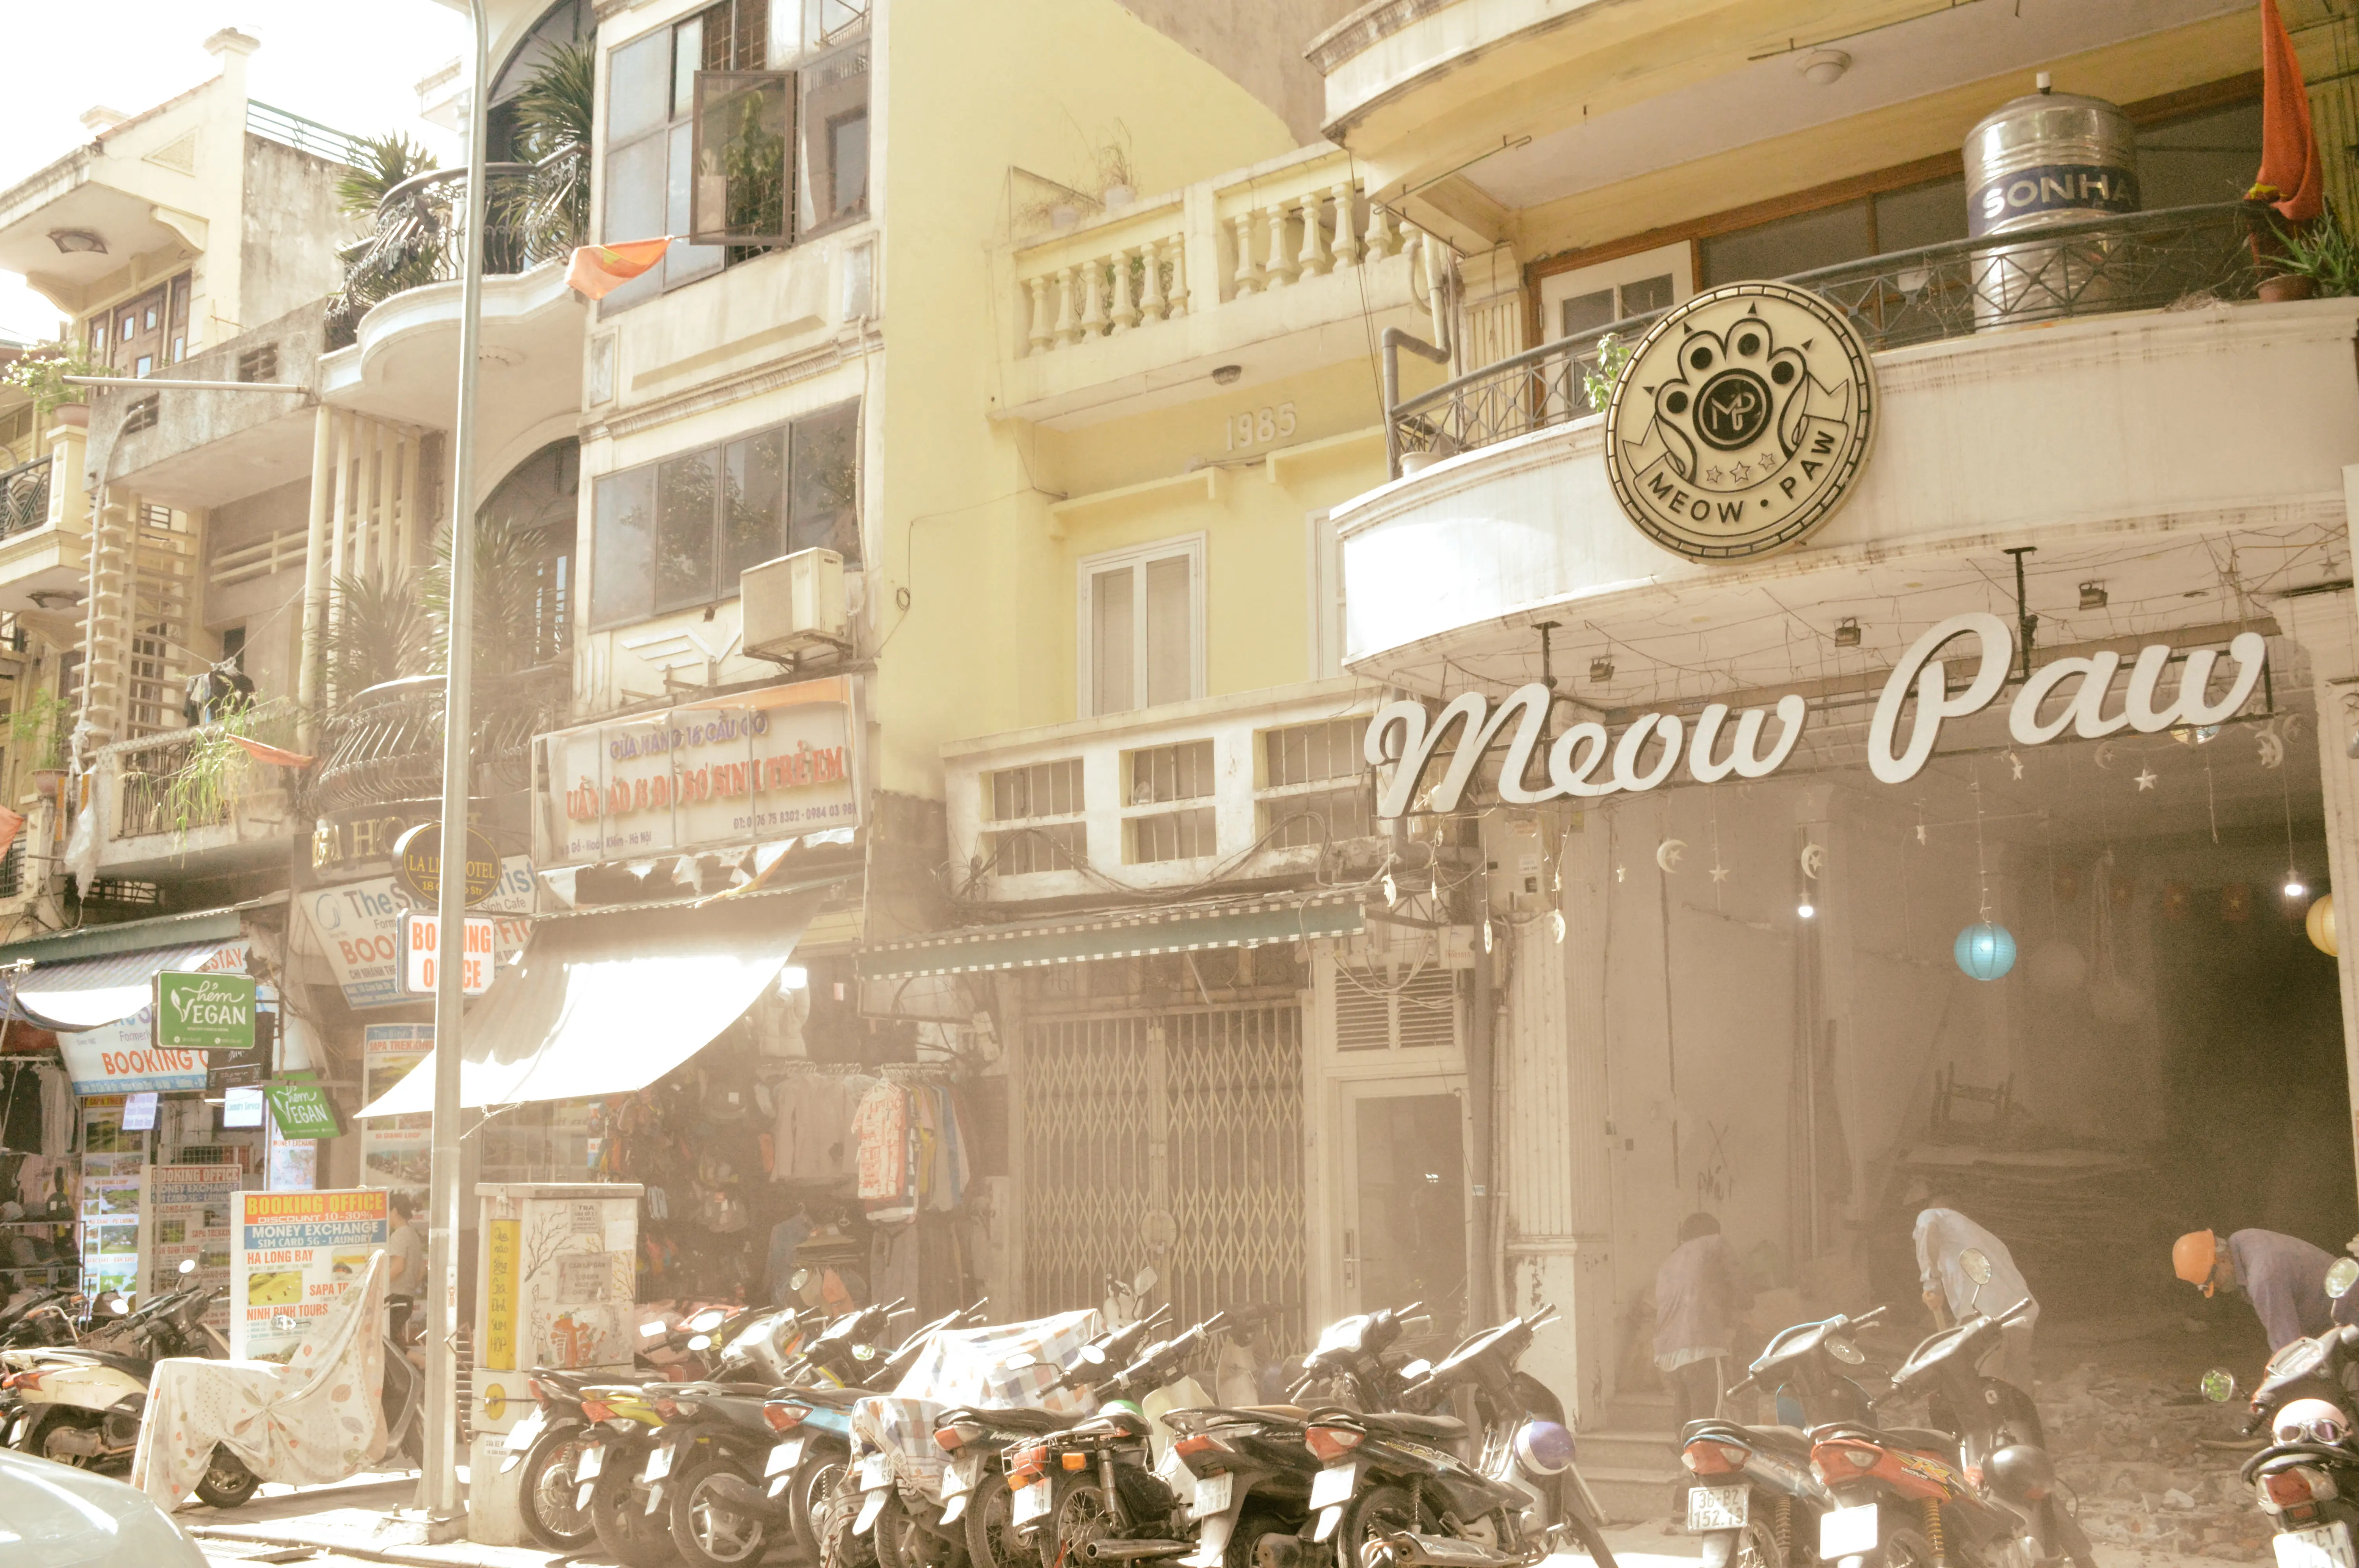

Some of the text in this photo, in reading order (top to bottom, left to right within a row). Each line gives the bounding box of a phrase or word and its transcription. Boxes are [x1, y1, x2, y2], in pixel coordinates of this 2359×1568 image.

[1226, 401, 1296, 452] 1985
[1647, 430, 1836, 524] MEOW PAW
[706, 710, 736, 742] CẦU
[1364, 612, 2266, 818] Meow Paw
[684, 762, 709, 801] SƠ
[766, 740, 808, 789] TRẺ
[812, 746, 844, 781] EM
[747, 813, 765, 827] 076
[780, 809, 800, 823] 8302
[806, 806, 827, 820] 0984
[829, 804, 839, 817] 03
[586, 837, 601, 851] Hoà
[629, 833, 638, 845] Hà
[640, 831, 651, 846] Nội
[409, 855, 425, 872] LA
[466, 861, 495, 879] OTEL
[422, 881, 434, 891] 18
[470, 886, 482, 895] Str
[493, 860, 536, 897] rist
[374, 919, 396, 929] Form
[504, 897, 526, 910] Cafe
[412, 922, 491, 954] BOING
[423, 958, 482, 989] OCE
[181, 980, 245, 1002] hẻm
[170, 989, 246, 1025] VEGAN
[369, 1041, 387, 1051] SAPA
[102, 1049, 193, 1076] BOOKING
[272, 1094, 328, 1124] VEGAN
[203, 1167, 239, 1182] OFFICE
[187, 1183, 238, 1192] EXCHANGE
[247, 1193, 383, 1215] BOOKING OFFICE
[258, 1210, 373, 1224] DISCOUNT 10-30%
[208, 1229, 231, 1237] TREKKIN
[252, 1221, 378, 1238] MONEY EXCHANGE
[258, 1234, 373, 1248] SIM CARD 5G LAUNDRY
[247, 1249, 314, 1265] HA LONG BAY
[309, 1283, 334, 1296] SAPA
[247, 1307, 270, 1321] NINH
[273, 1305, 296, 1318] BINH
[298, 1303, 328, 1317] TOURS
